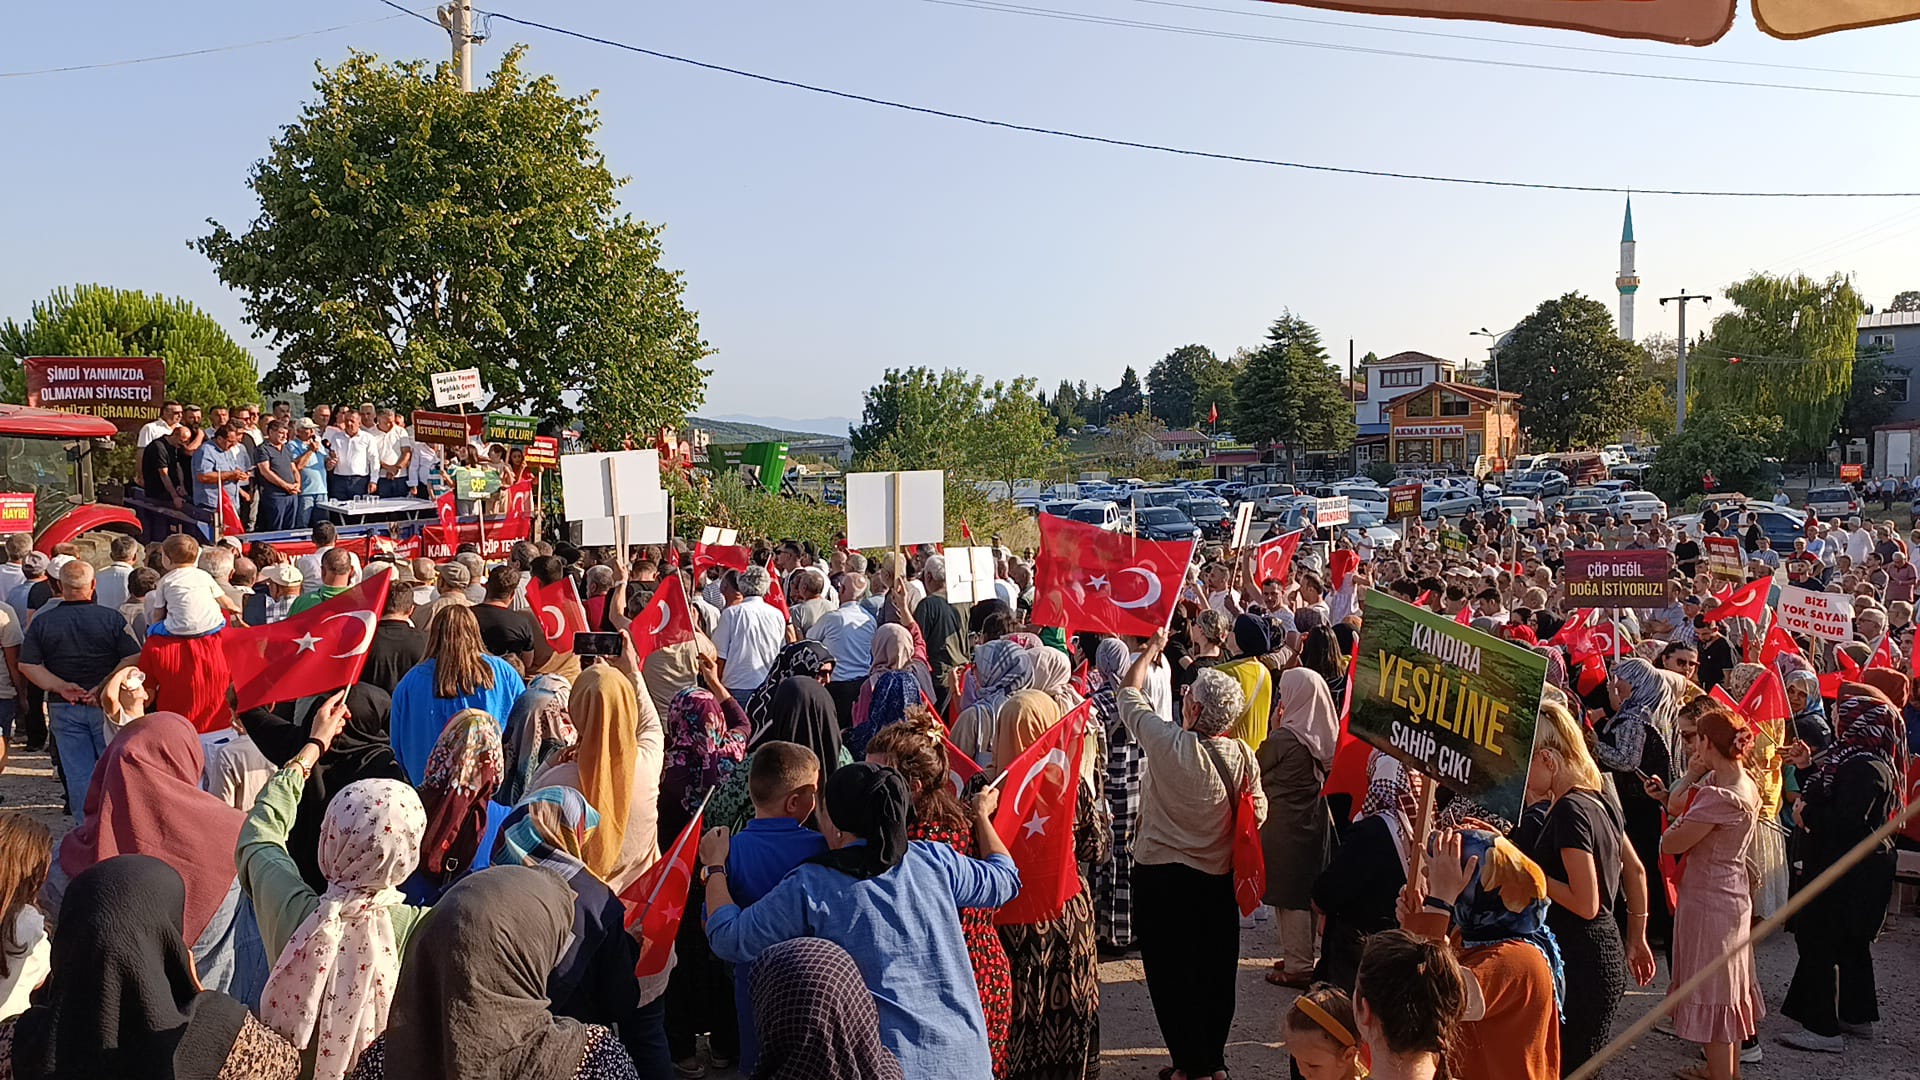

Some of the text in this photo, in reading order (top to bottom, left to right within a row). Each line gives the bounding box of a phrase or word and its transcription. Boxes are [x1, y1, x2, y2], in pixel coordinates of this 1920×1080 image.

[47, 367, 144, 382] ŞİMDİ YANIMIZDA
[41, 385, 152, 403] OLMAYAN SİYASETÇİ
[93, 403, 161, 420] UĞRAMASIN!
[490, 427, 534, 441] YOK OLUR!
[1395, 426, 1462, 436] AKMAN EMLAK
[2, 508, 29, 520] HAYIR!
[1587, 561, 1644, 579] ÇÖP DEĞİL
[1569, 580, 1663, 596] DOĞA İSTİYORUZ!
[1782, 603, 1848, 623] YOK SAYAN
[1786, 617, 1844, 636] YOK OLUR
[1411, 621, 1481, 675] KANDIRA
[1378, 649, 1510, 756] YEŞİLİNE
[1390, 720, 1472, 784] SAHİP ÇIK!
